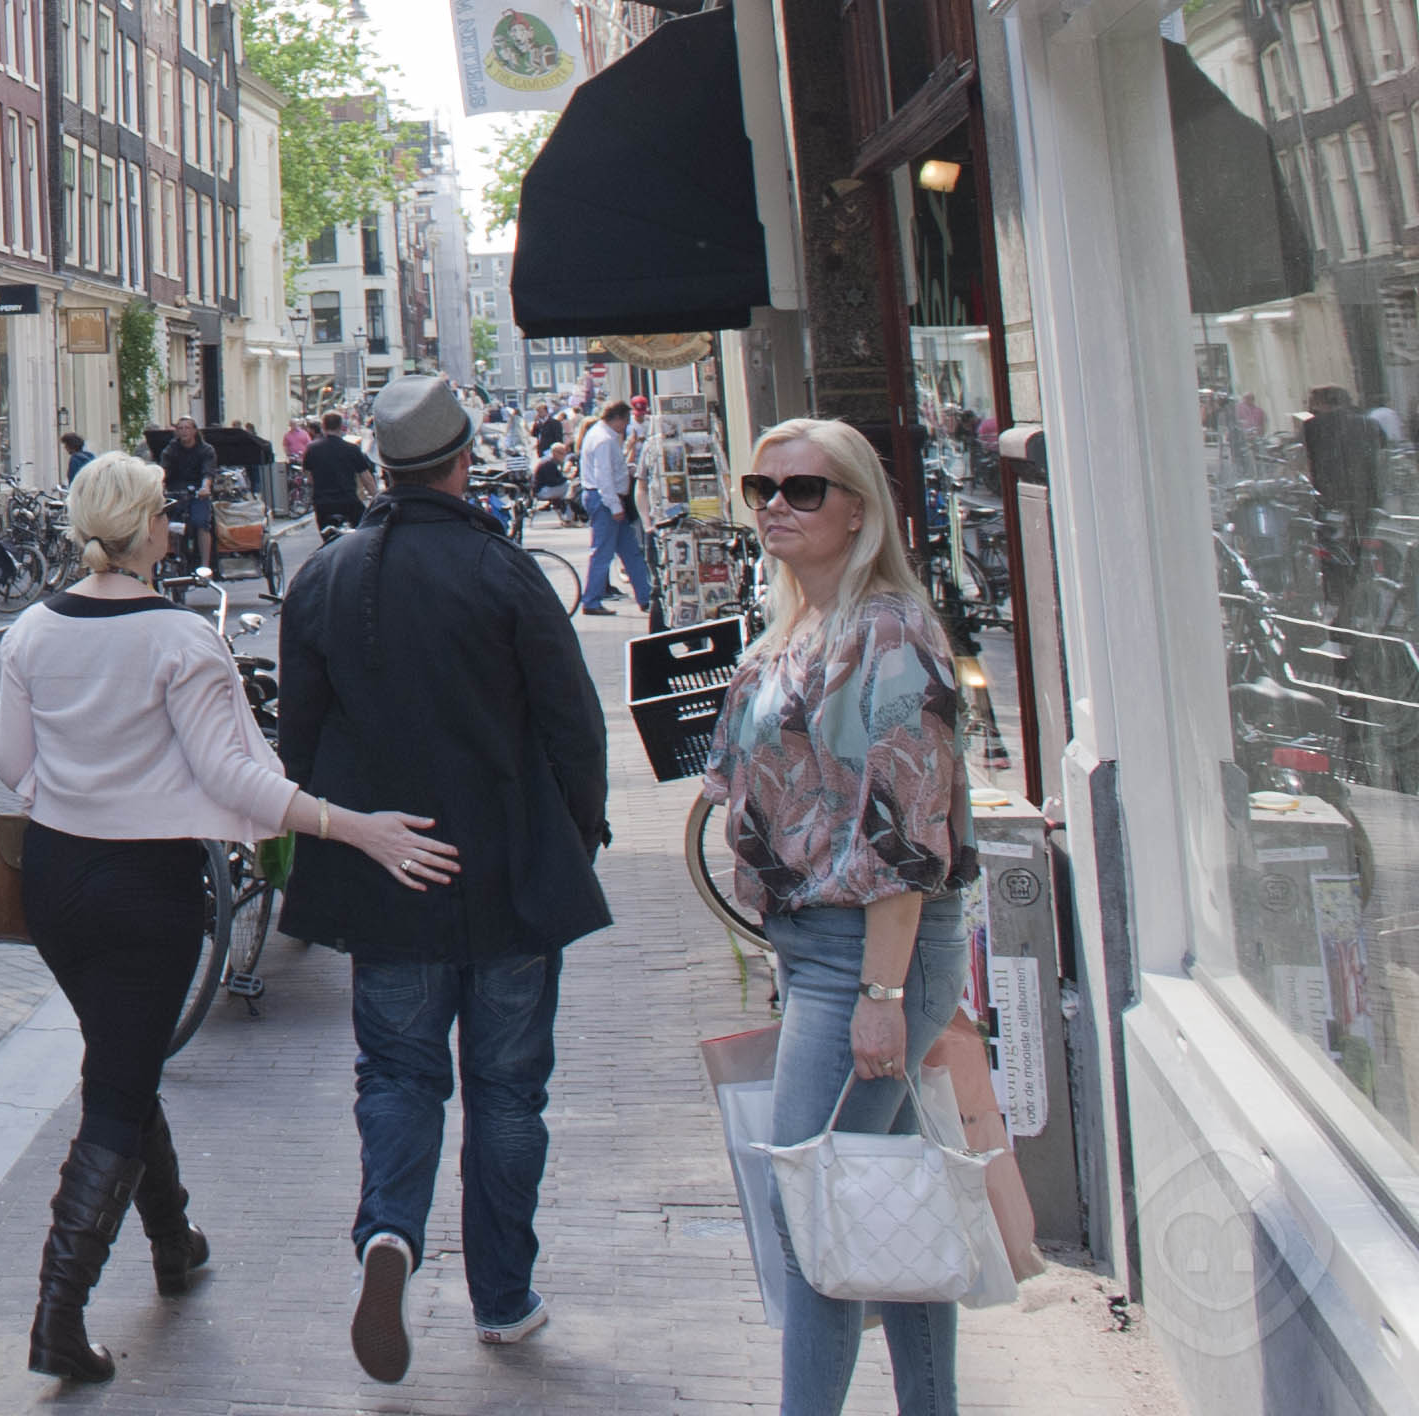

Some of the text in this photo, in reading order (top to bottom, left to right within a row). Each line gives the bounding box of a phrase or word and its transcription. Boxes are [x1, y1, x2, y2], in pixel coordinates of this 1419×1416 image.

[1020, 1031, 1034, 1078] mooiste
[1023, 1082, 1035, 1096] de
[1025, 1100, 1036, 1126] voor
